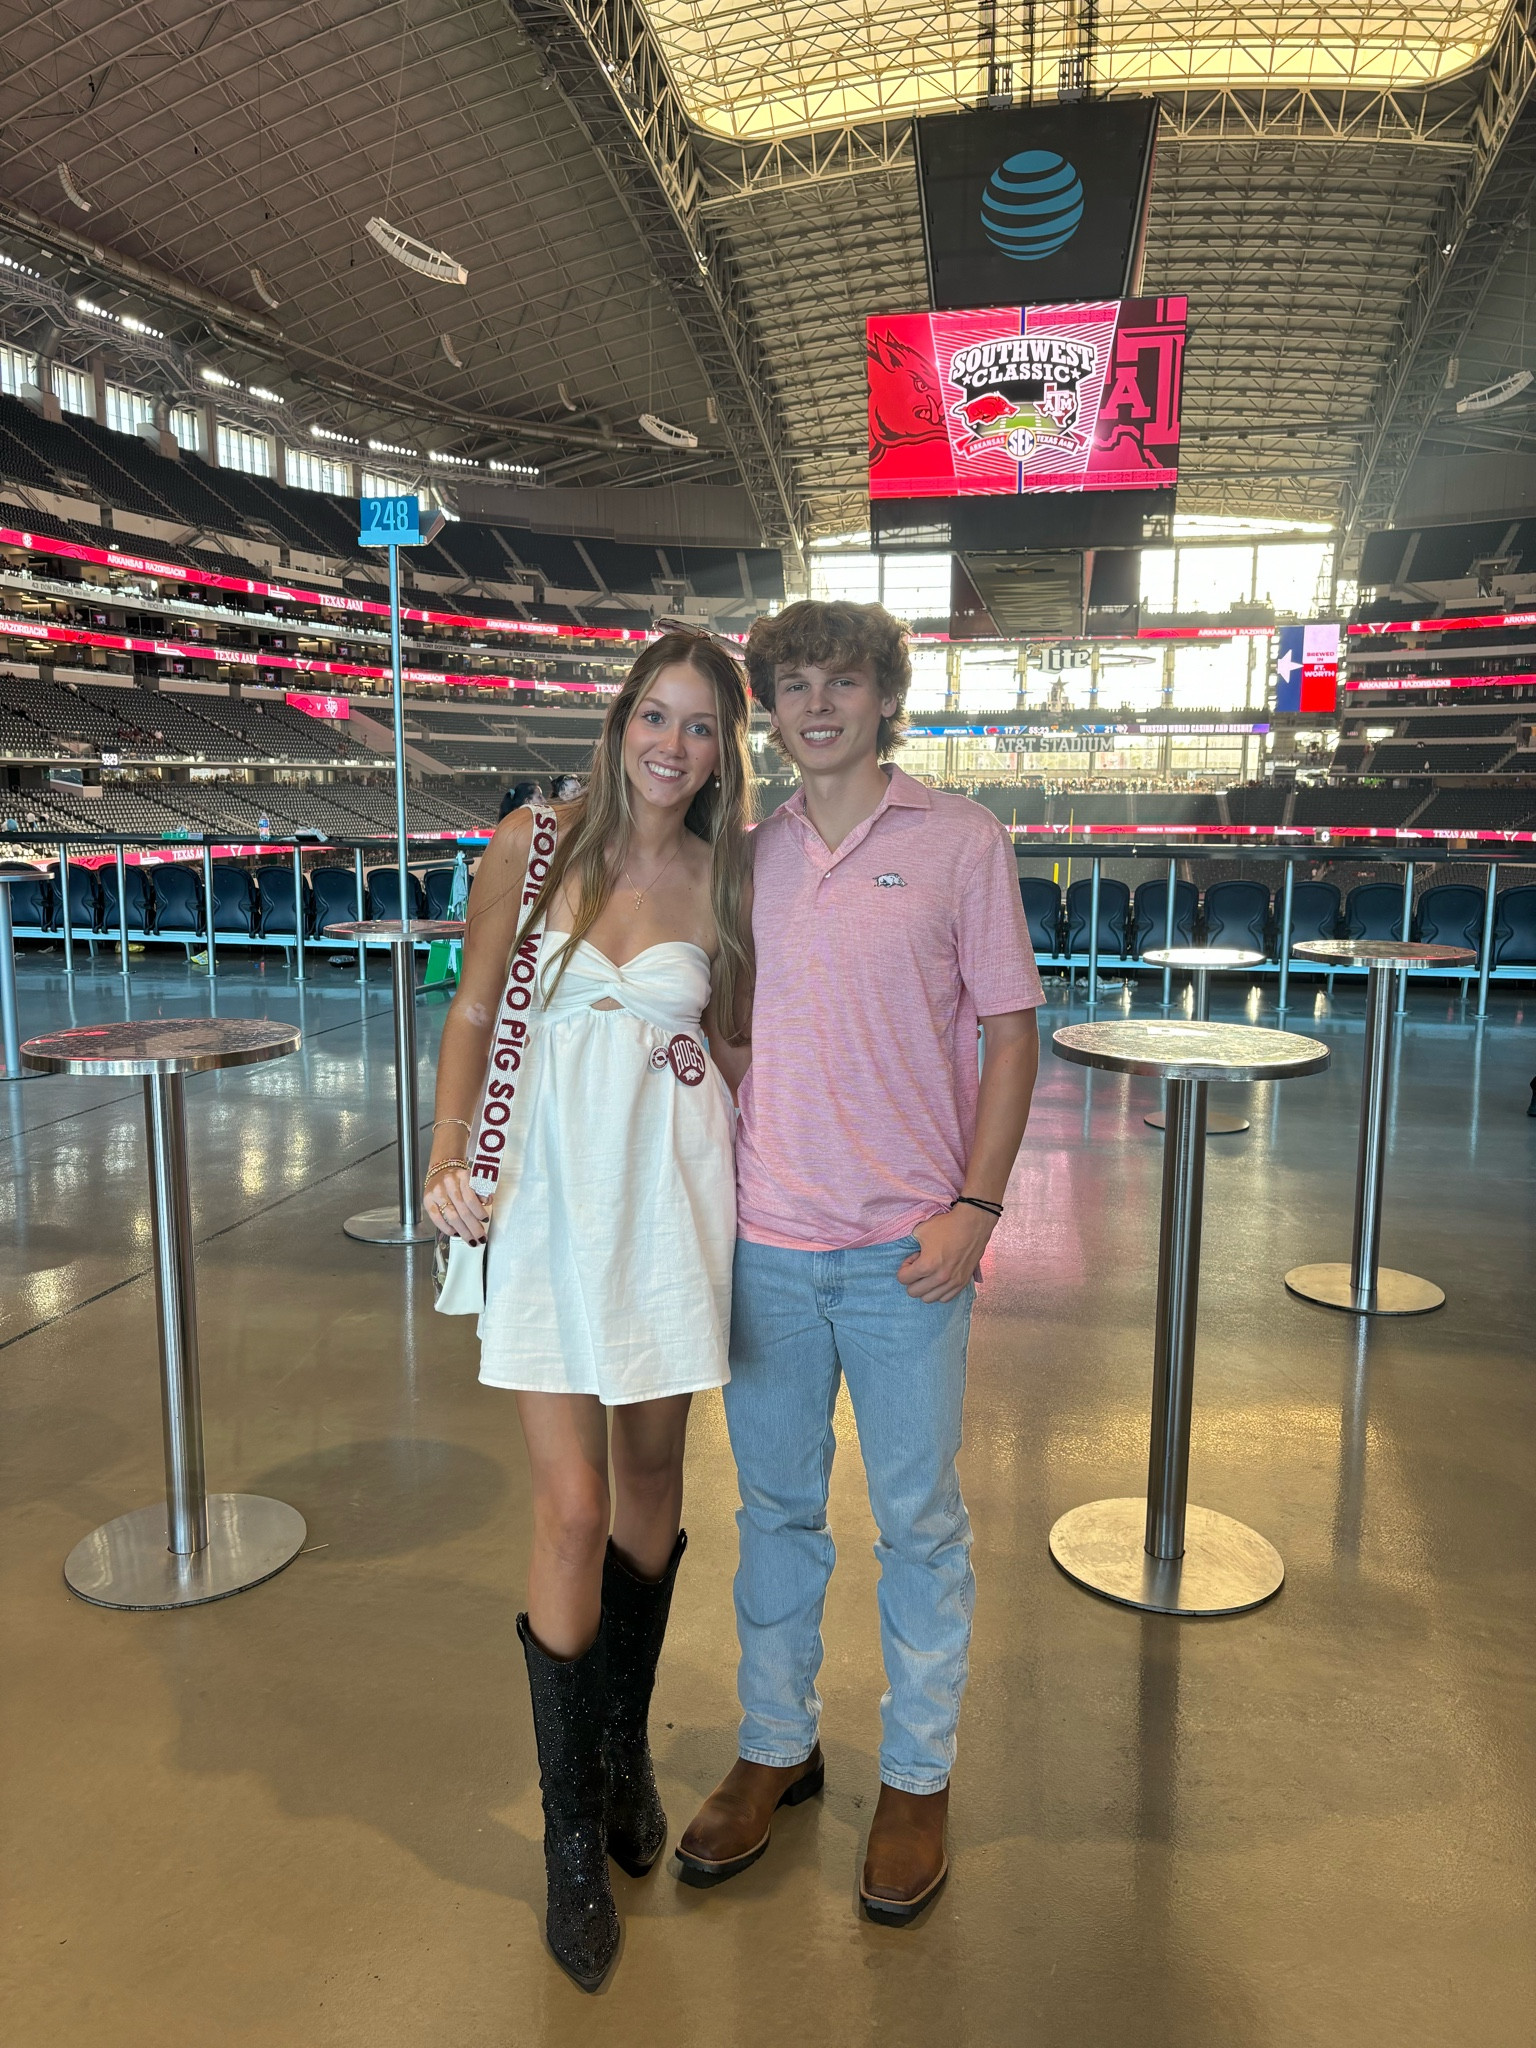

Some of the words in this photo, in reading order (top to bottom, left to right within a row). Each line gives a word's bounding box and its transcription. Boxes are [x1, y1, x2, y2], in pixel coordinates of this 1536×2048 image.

[952, 340, 1094, 374] SOUTHWEST
[971, 363, 1070, 387] CLASSIC
[969, 436, 1005, 451] ARKANSAS
[1009, 429, 1034, 456] SEC
[1036, 434, 1058, 445] TEXAS
[1058, 439, 1075, 450] A&M
[370, 500, 409, 531] 248
[107, 554, 144, 570] ARKANSAS
[145, 562, 187, 578] RAZORBACKS
[318, 593, 345, 608] TEXAS
[345, 599, 363, 612] A&M
[0, 622, 48, 638] RAZORBACKS
[486, 620, 518, 629] ARKANSAS
[519, 623, 559, 633] RAZORBACKS
[214, 650, 240, 661] TEXAS
[240, 654, 258, 665] A&M
[1039, 648, 1090, 674] Lite
[1358, 681, 1399, 689] ARKANSAS
[1401, 680, 1451, 688] RAZORBACKS
[996, 737, 1036, 752] AT&T
[1040, 737, 1114, 752] STADIUM
[1433, 830, 1459, 839] TEXAS
[1459, 831, 1478, 839] A&M
[171, 850, 196, 861] TEXAS
[523, 813, 556, 906] SOOIE
[506, 934, 542, 1011] WOO
[494, 1019, 527, 1072] PIG
[671, 1040, 705, 1076] HOGS
[472, 1079, 515, 1182] SOOIE
